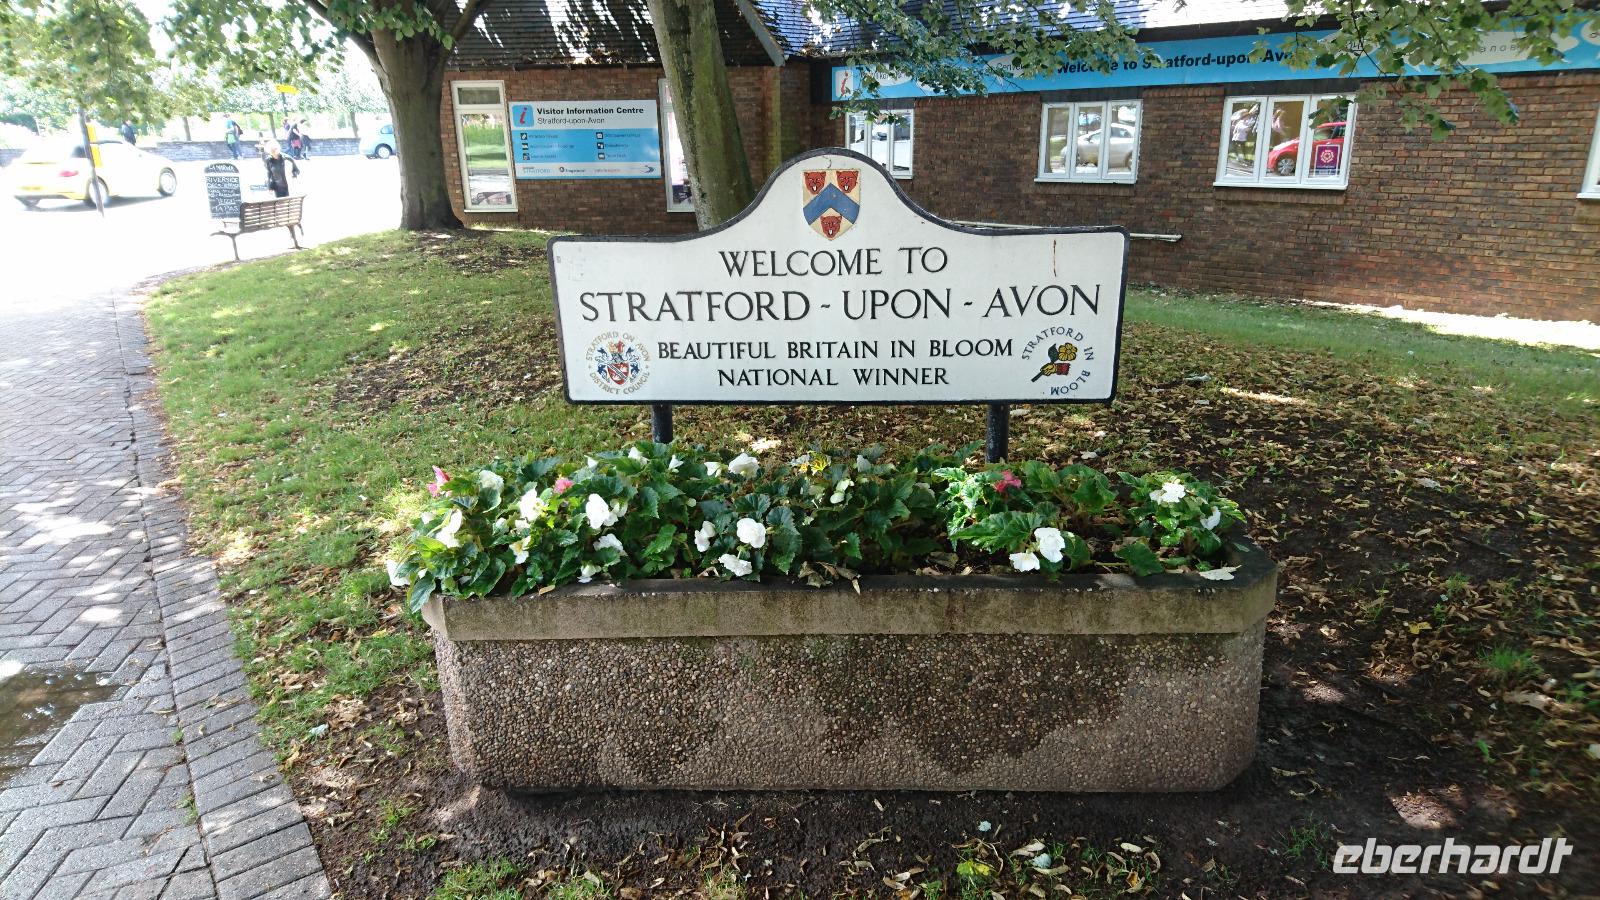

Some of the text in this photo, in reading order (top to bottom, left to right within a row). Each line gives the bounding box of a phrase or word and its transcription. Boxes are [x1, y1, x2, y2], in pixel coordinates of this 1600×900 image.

[1057, 60, 1118, 74] Welce
[1123, 59, 1138, 71] to
[537, 106, 644, 115] Visitor Information Centre
[718, 246, 948, 277] WELCOME TO
[579, 290, 810, 322] STRATFORD
[842, 287, 951, 320] UPON
[982, 284, 1100, 318] AVON
[585, 331, 651, 362] STRATFORD ON AVON
[657, 338, 1013, 359] BEAUTIFUL BRITAIN IN BLOOM
[1021, 326, 1094, 395] STRATFORD IN BLOOM
[589, 371, 650, 395] DISTRICT COUNCIL
[718, 367, 949, 386] NATIONAL WINNER
